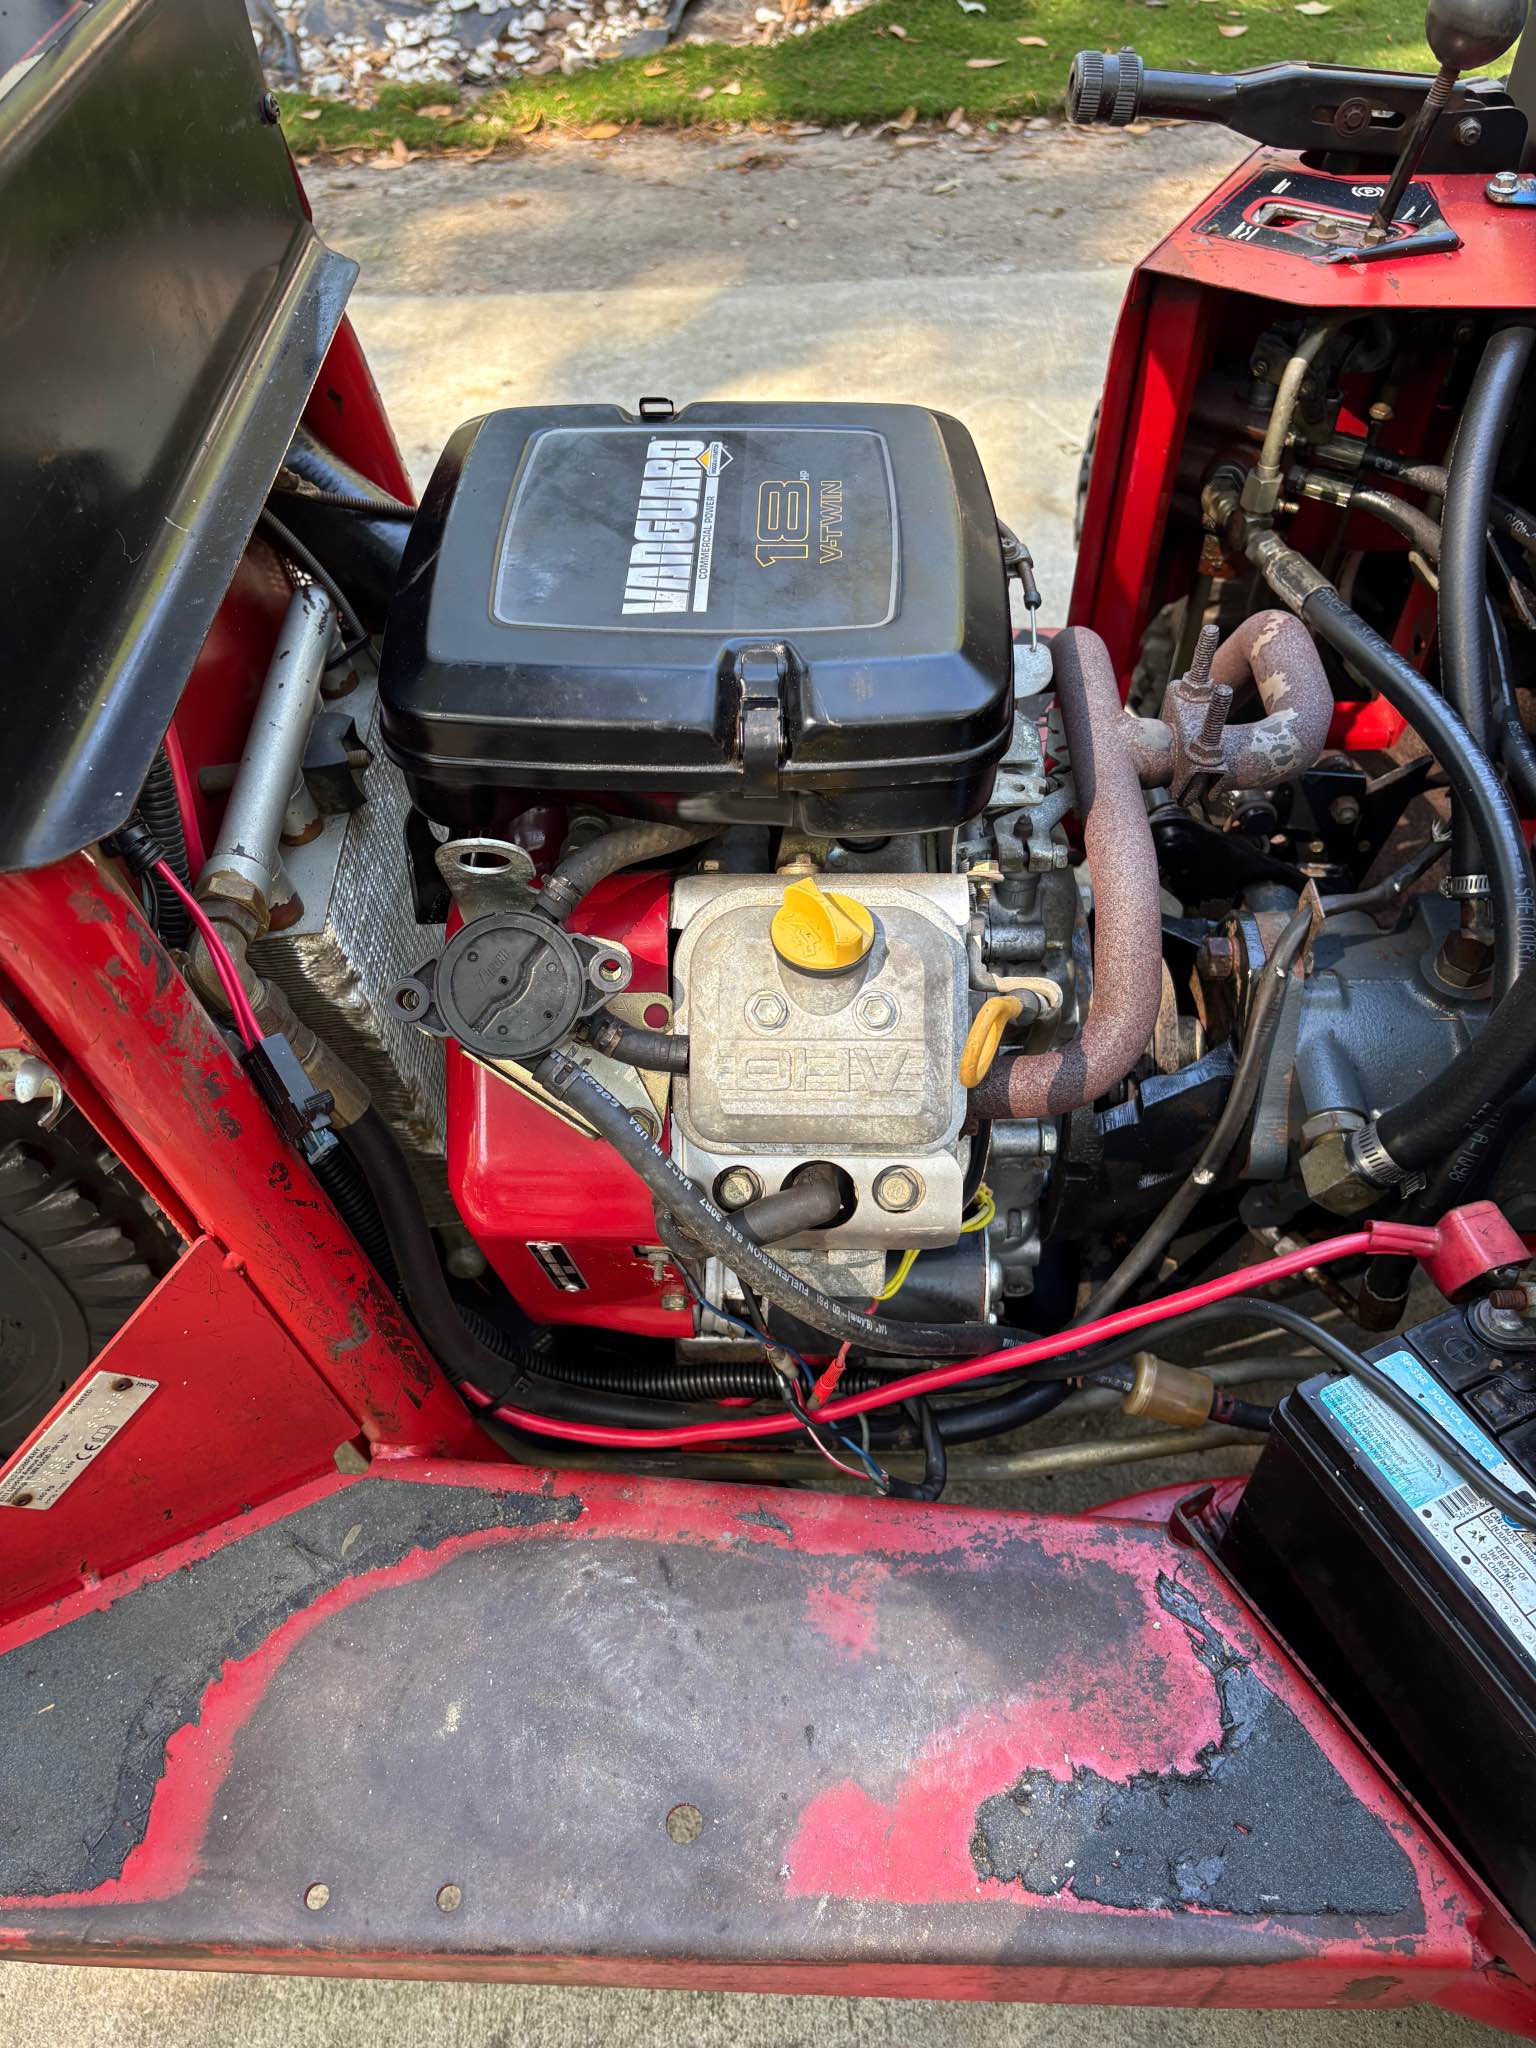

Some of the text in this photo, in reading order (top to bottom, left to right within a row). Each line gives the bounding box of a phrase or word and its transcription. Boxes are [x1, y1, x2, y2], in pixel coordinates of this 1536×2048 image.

[621, 438, 706, 615] VANGUARD
[698, 495, 715, 579] COMMERCIAL POWER
[754, 479, 810, 567] 18
[818, 479, 844, 565] V-TWIN
[741, 1045, 909, 1094] OHV
[625, 1114, 651, 1140] USA
[649, 1141, 664, 1156] IN
[698, 1195, 724, 1222] 30R7
[722, 1220, 745, 1242] SAE
[743, 1241, 811, 1296] FUEL/EMISSION
[1429, 1388, 1446, 1406] 300
[1481, 1445, 1495, 1461] CA
[15, 1446, 40, 1475] COMPANY
[1482, 1514, 1512, 1548] OR INJURY.
[1489, 1510, 1502, 1525] CAN
[1499, 1523, 1519, 1543] CAUSE
[1479, 1552, 1517, 1593] OF CHILDREN.
[1486, 1548, 1517, 1581] THE REACH
[1493, 1544, 1528, 1582] KEEP OUT OF
